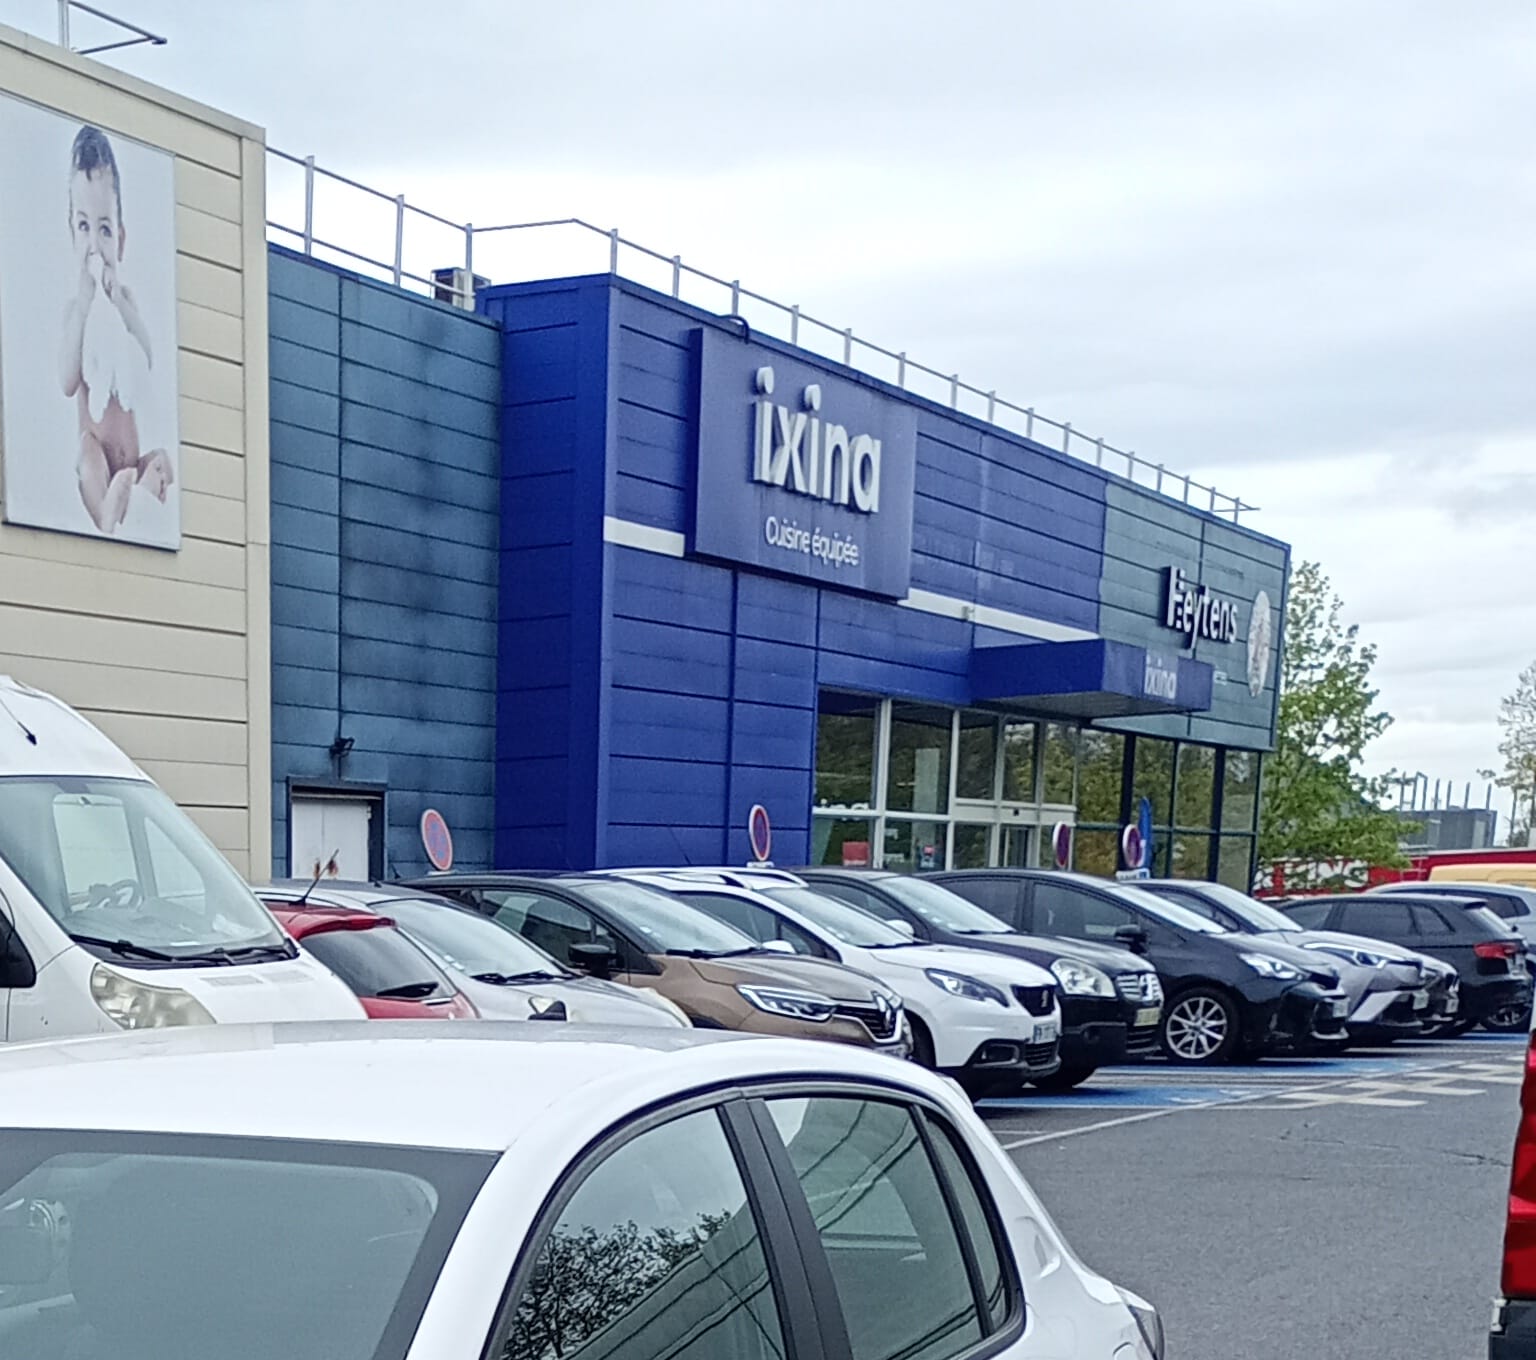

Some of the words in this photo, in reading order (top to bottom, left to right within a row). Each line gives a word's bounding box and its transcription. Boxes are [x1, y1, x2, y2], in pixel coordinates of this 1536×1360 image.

[753, 366, 882, 513] ixina
[765, 516, 810, 553] Cuisine
[811, 527, 860, 568] équipée
